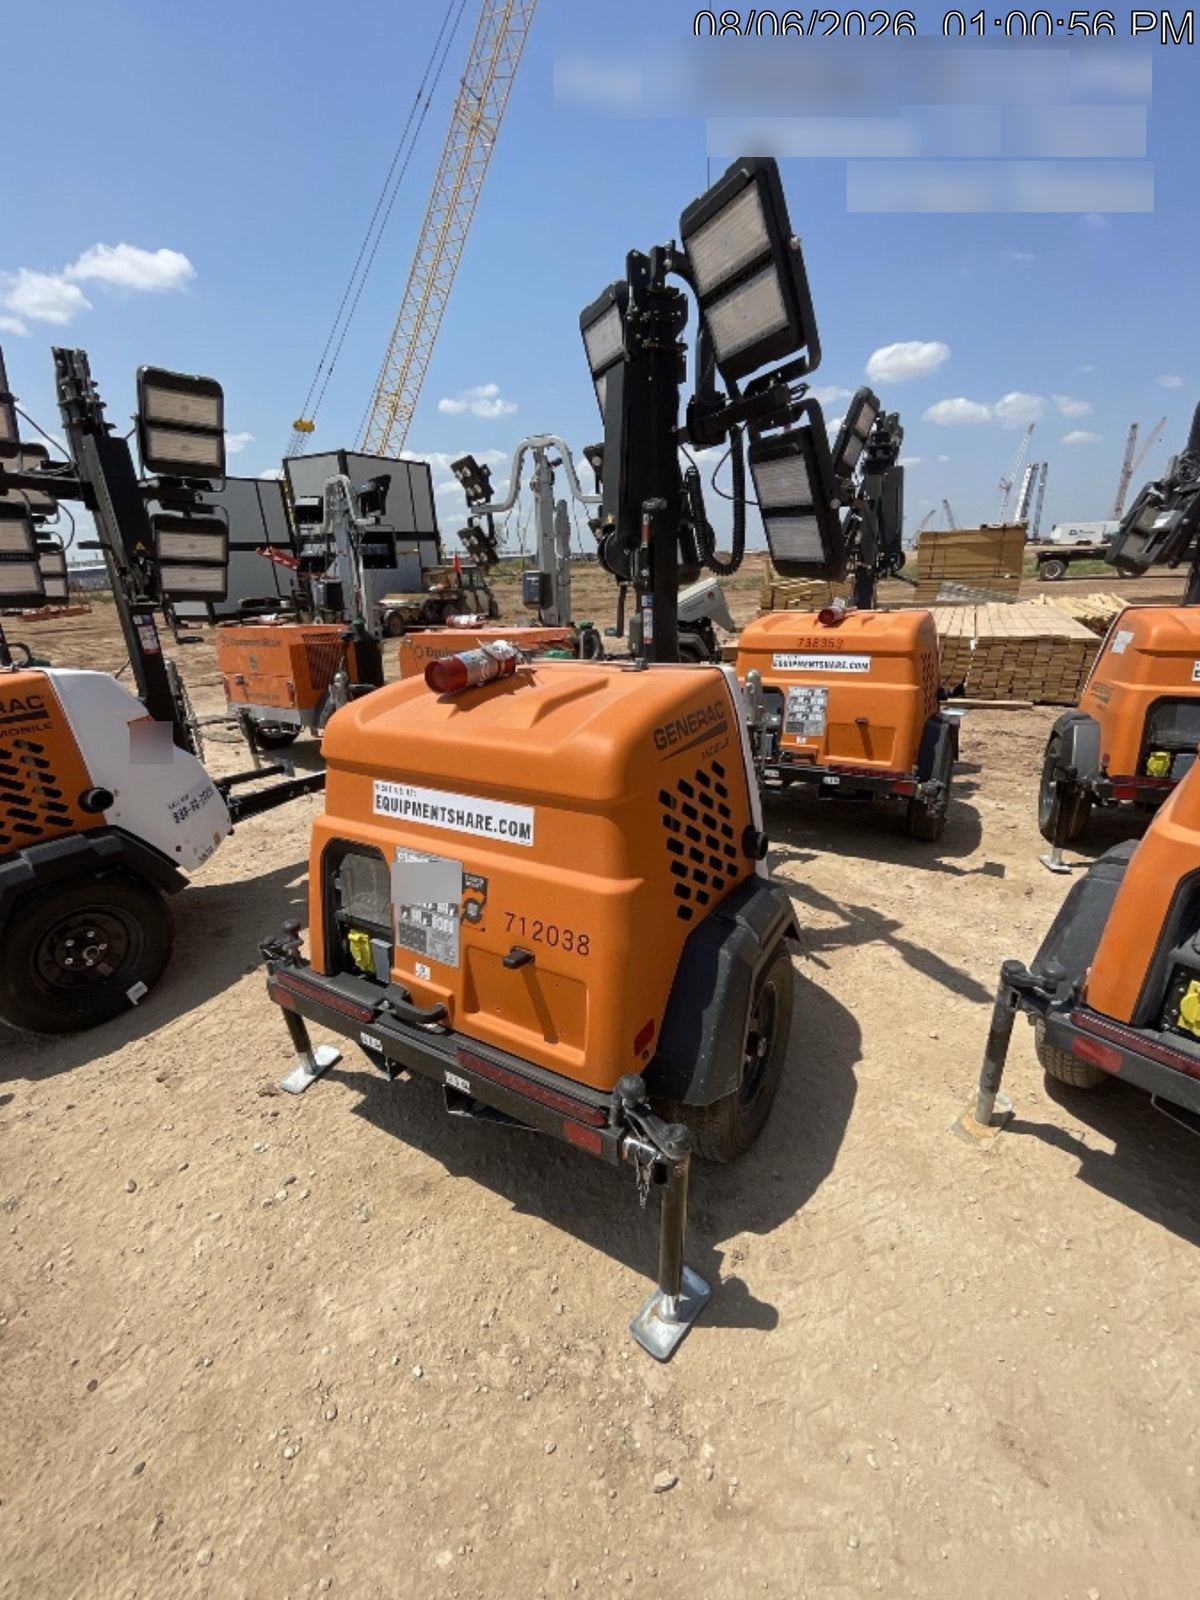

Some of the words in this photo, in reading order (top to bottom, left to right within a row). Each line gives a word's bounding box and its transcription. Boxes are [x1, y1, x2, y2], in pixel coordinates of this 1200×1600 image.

[654, 699, 726, 752] GENERAC
[375, 794, 532, 841] EQUIPMENTSHARE.COM
[504, 911, 590, 957] 712038
